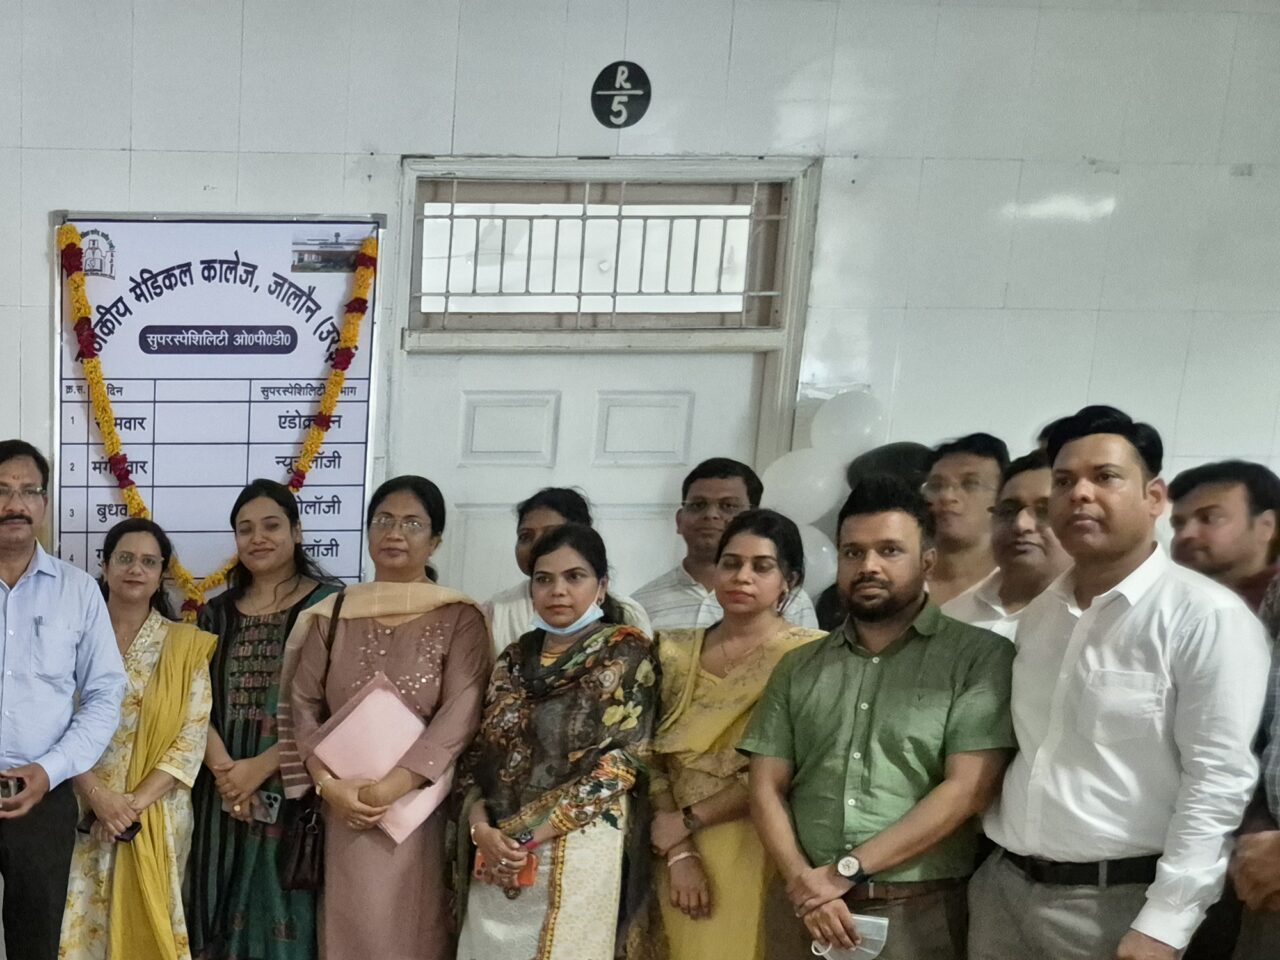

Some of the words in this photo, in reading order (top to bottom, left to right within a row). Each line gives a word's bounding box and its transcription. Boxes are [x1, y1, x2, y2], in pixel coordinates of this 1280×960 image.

[614, 65, 632, 89] R
[609, 95, 629, 125] 5
[128, 261, 194, 303] मेडिकल
[267, 271, 322, 323] जालौन
[106, 383, 124, 396] दिन
[94, 417, 147, 431] मवार
[69, 462, 75, 472] 2
[91, 456, 148, 475] मंगवार
[69, 509, 75, 518] 3
[96, 503, 132, 523] बुधव
